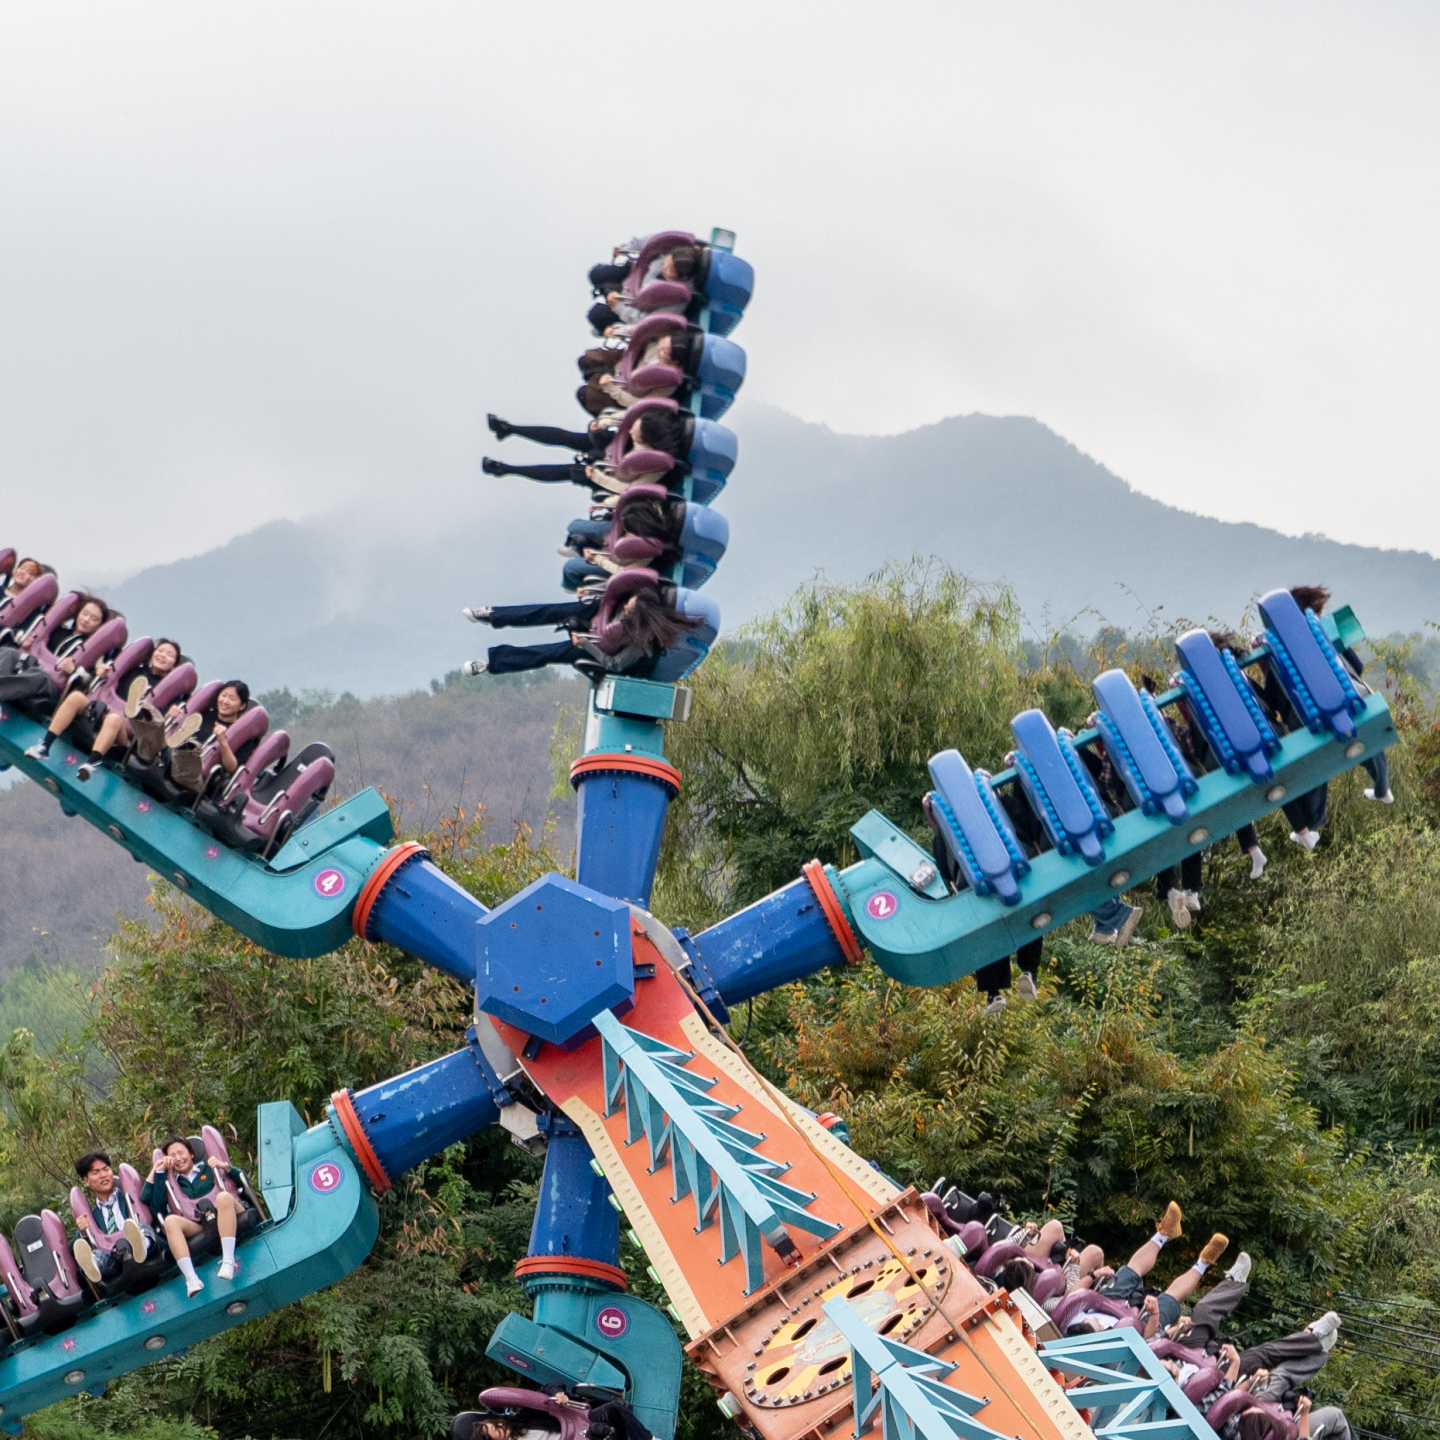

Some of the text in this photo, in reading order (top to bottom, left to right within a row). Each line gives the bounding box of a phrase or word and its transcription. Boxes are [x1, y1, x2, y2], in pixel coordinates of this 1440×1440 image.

[321, 874, 339, 892] 4
[874, 896, 891, 916] 2
[318, 1167, 334, 1187] 5
